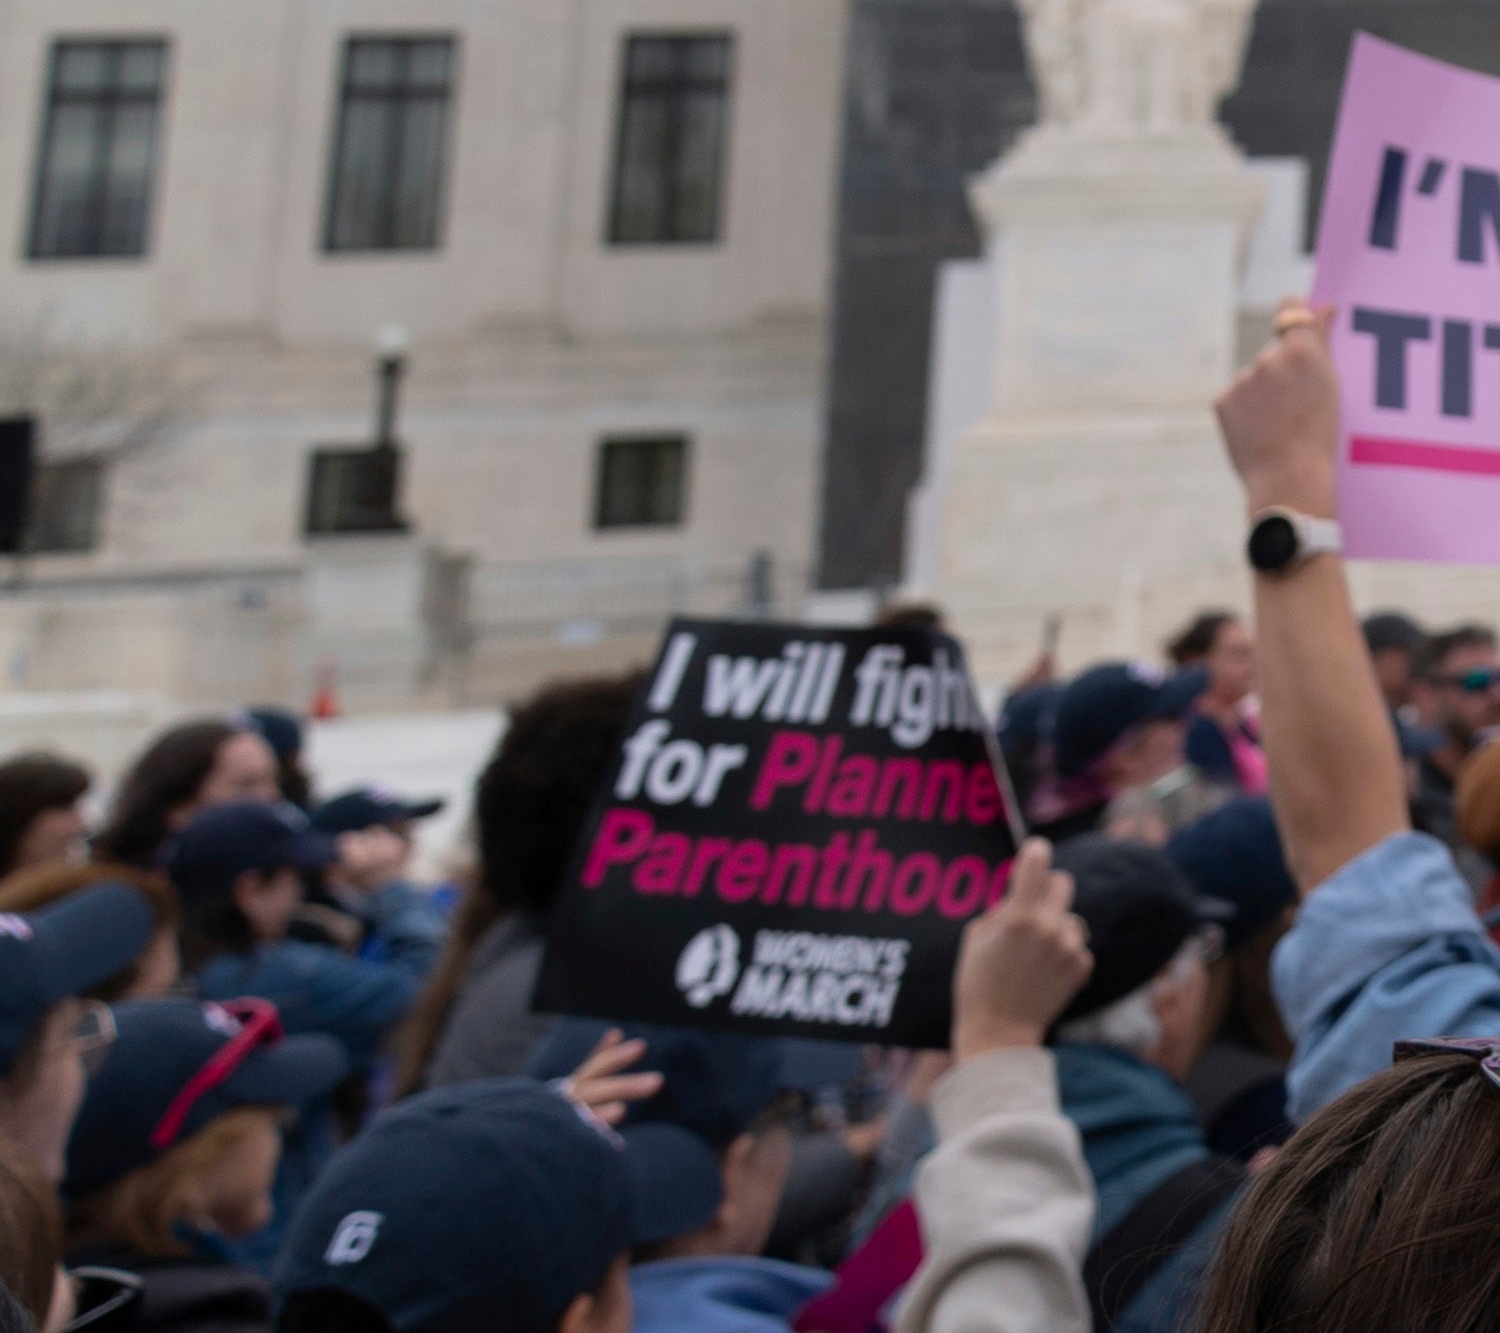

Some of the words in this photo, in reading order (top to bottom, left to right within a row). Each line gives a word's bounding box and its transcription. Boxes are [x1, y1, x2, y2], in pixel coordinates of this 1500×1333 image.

[647, 632, 697, 714] I
[703, 640, 847, 724] will
[849, 644, 980, 749] figh
[614, 717, 748, 807] for
[748, 730, 1008, 825] Planne
[731, 961, 902, 1029] MARCH
[750, 927, 912, 978] WOMEN'S
